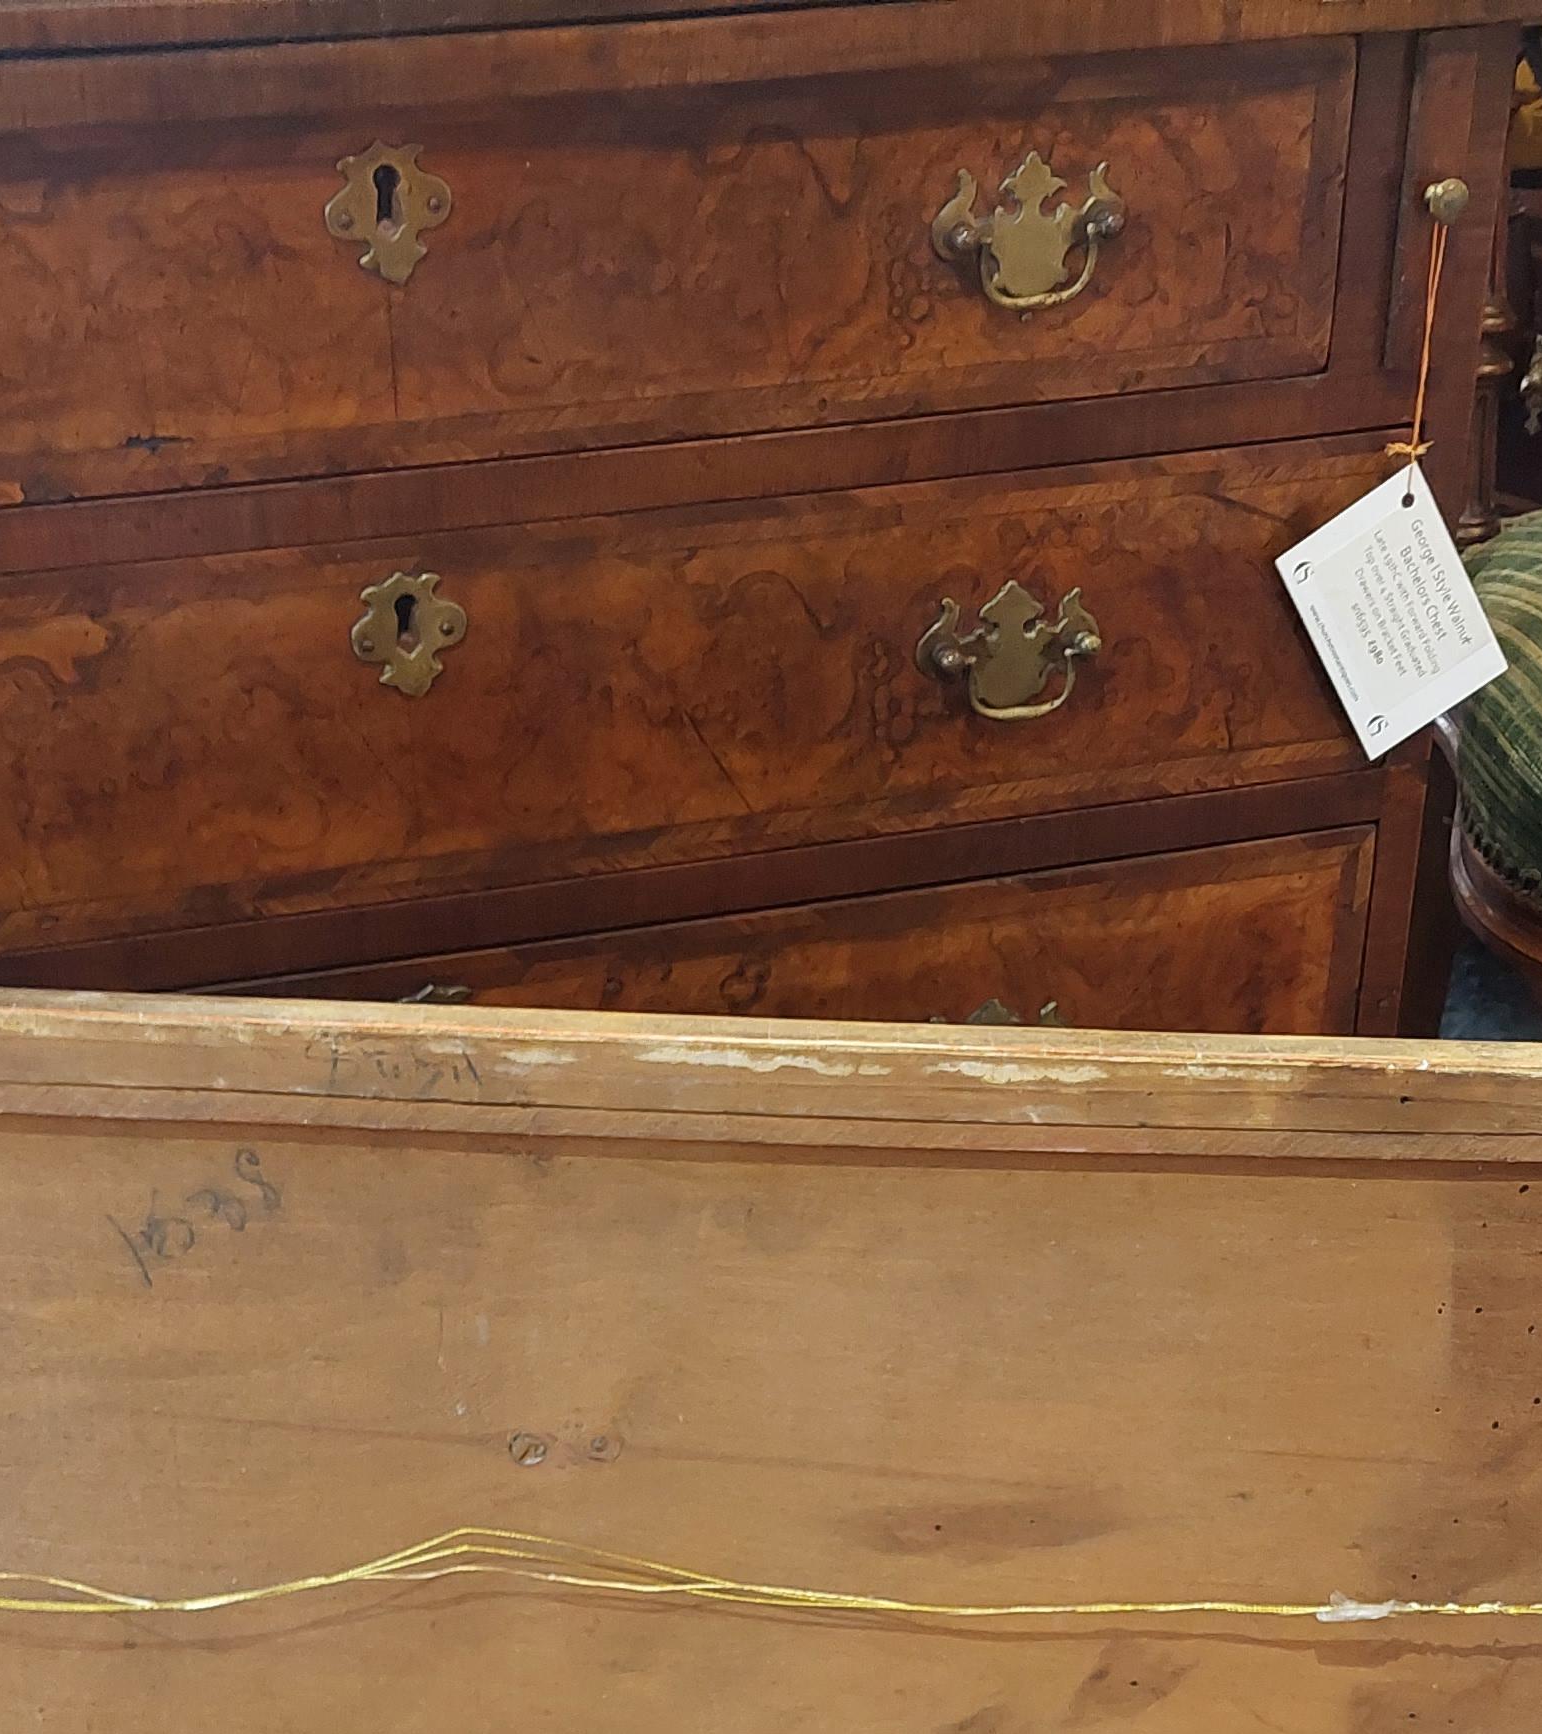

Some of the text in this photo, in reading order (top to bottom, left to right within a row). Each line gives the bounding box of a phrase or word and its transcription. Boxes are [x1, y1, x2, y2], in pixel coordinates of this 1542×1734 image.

[1398, 543, 1448, 642] Bachelors Chest
[1409, 517, 1436, 566] George
[1430, 568, 1452, 604] Style
[1445, 598, 1474, 646] Walnut
